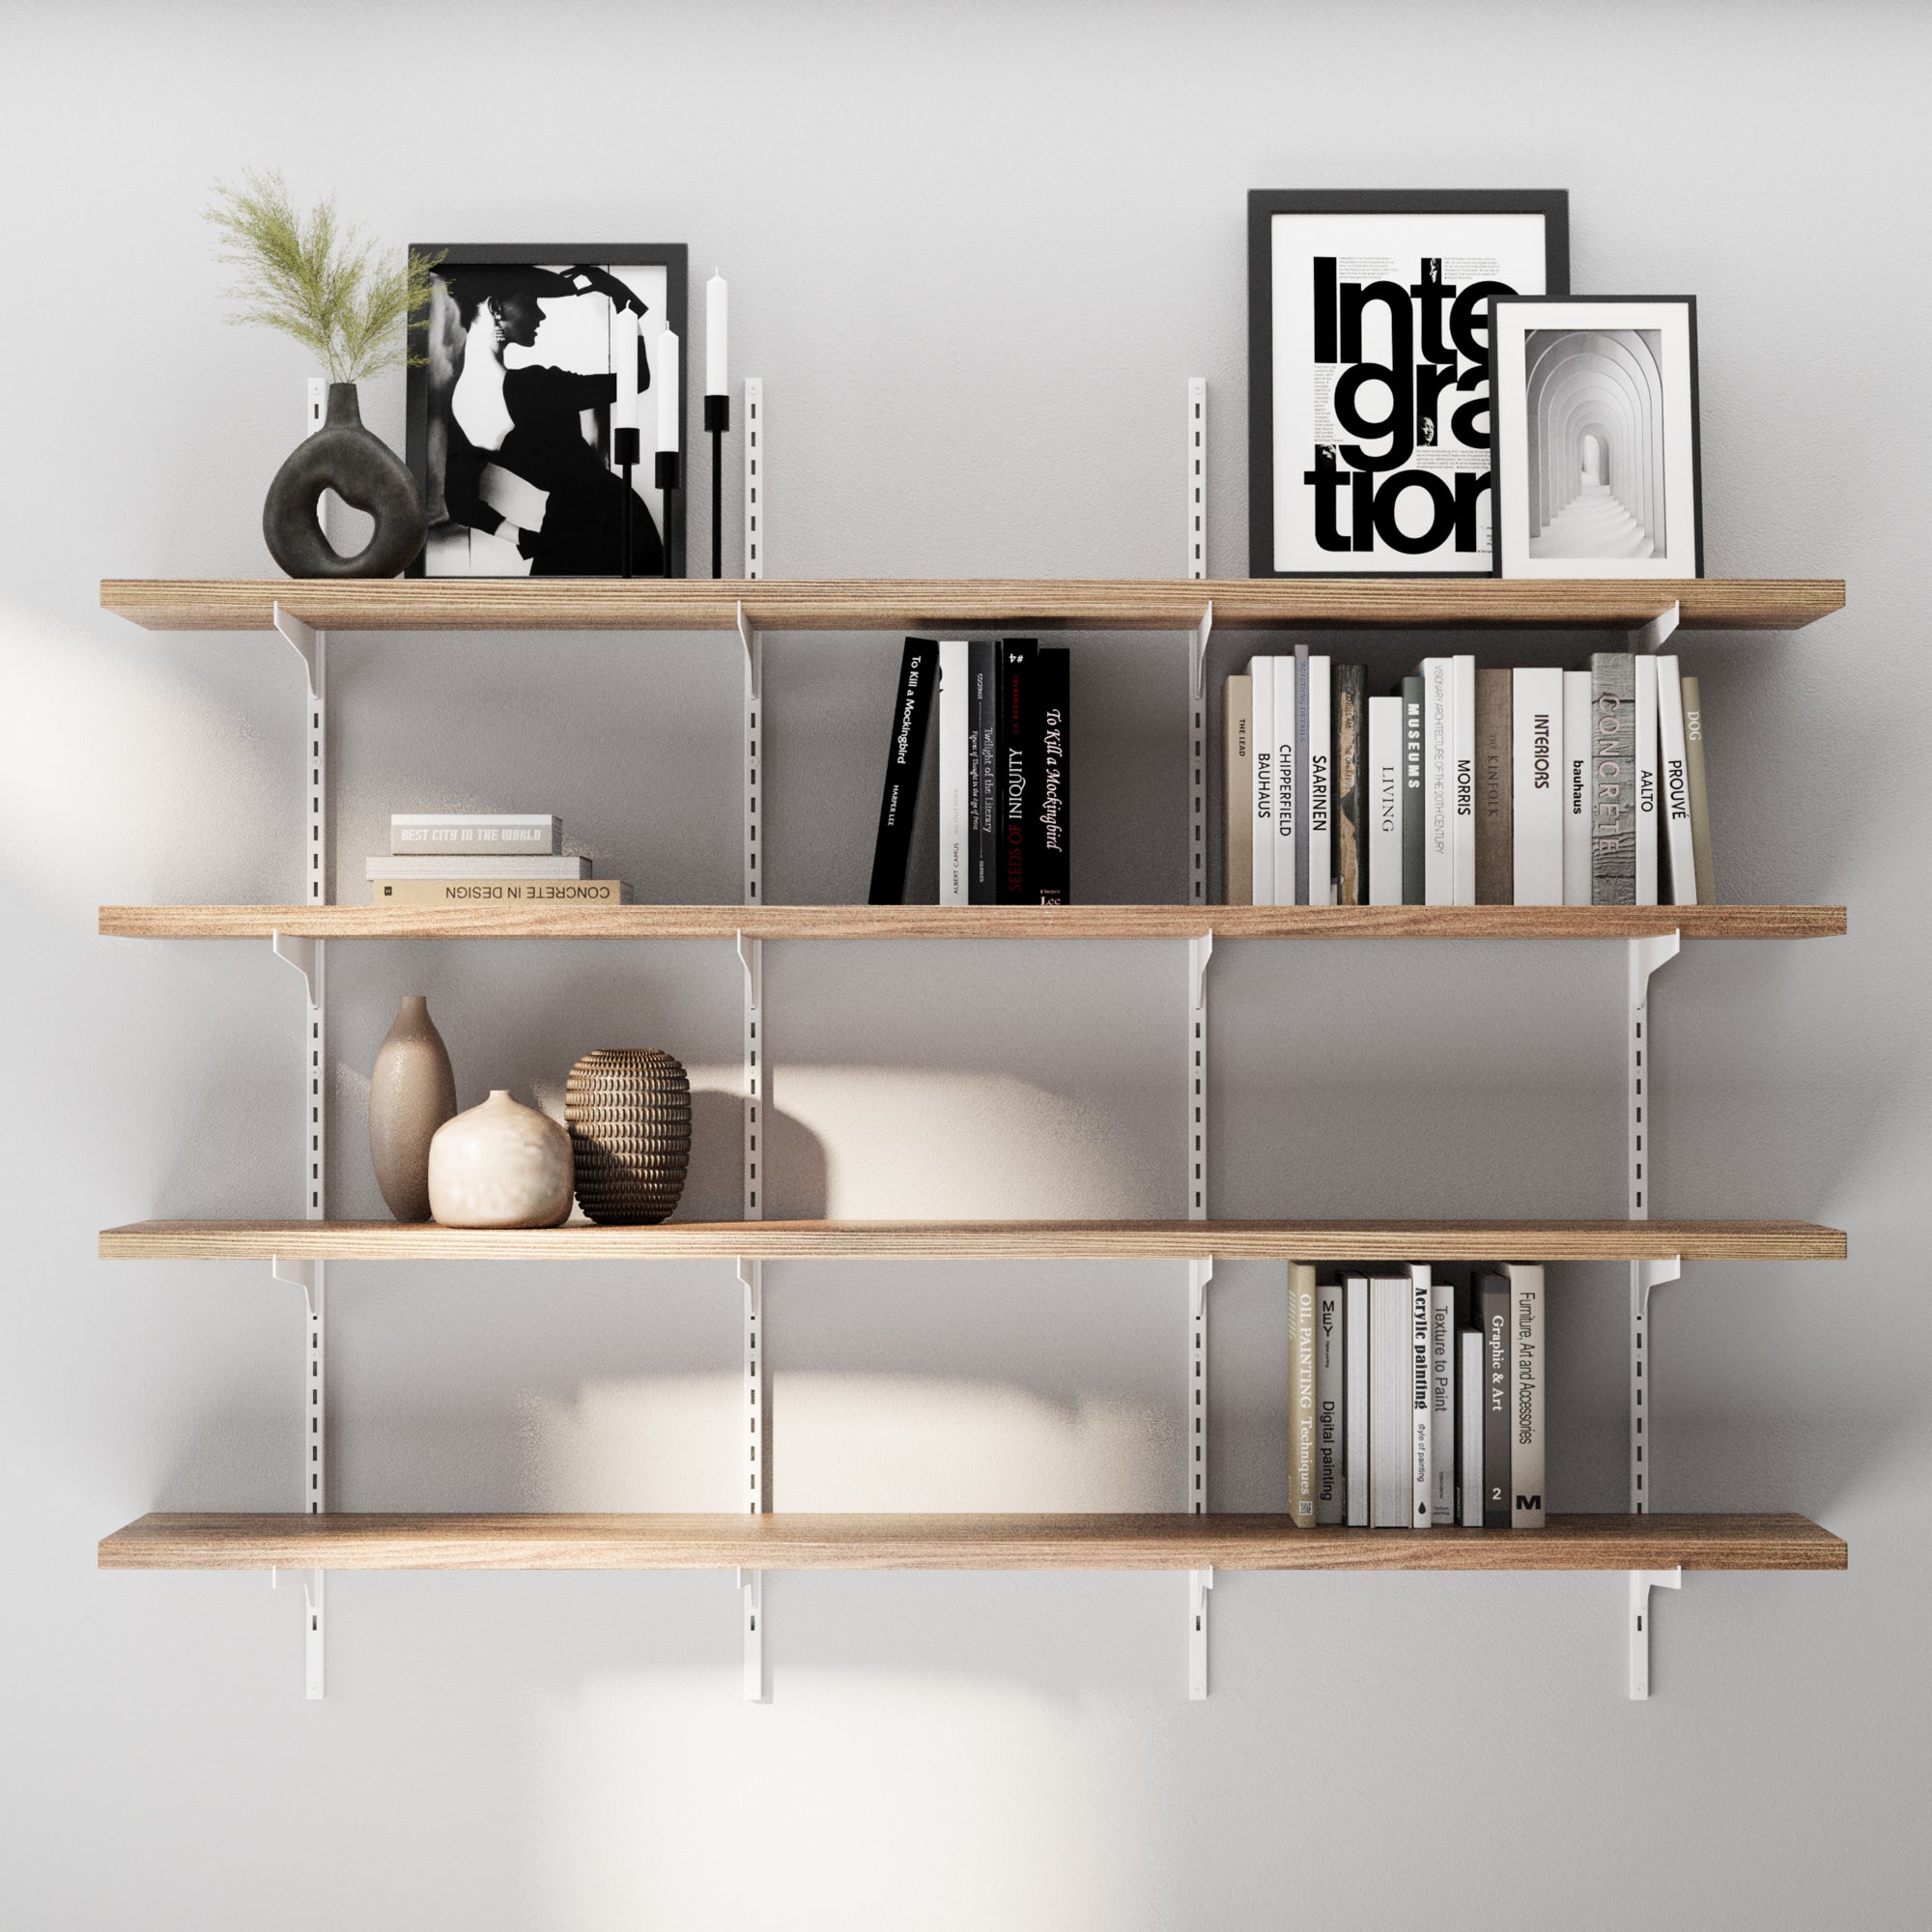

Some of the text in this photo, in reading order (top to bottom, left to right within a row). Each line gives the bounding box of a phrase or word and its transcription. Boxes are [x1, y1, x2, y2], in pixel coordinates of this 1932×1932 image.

[908, 671, 919, 687] Kill
[910, 656, 922, 668] To
[1009, 653, 1024, 664] #4
[1434, 665, 1444, 702] VISIONARY
[896, 697, 915, 764] Mockingbird
[1408, 703, 1420, 788] MUSEUMS
[1434, 702, 1444, 760] ARCHITECTURE
[1534, 714, 1549, 789] INTERIORS
[1687, 711, 1701, 741] DOG
[969, 758, 979, 781] Thought
[982, 726, 993, 833] Twilight of the Literary
[1039, 708, 1063, 853] To Kill a Mockingbird
[1258, 753, 1271, 818] BAUHAUS
[1279, 744, 1293, 837] CHIPPERFIELD
[1313, 755, 1327, 831] SAARINEN
[1434, 761, 1444, 774] OF
[1434, 774, 1444, 789] THE
[1457, 759, 1471, 816] MORRIS
[1488, 755, 1498, 817] KINFOLK
[1573, 760, 1584, 814] bauhaus
[1598, 693, 1621, 852] CONCRETE
[1640, 770, 1654, 812] AALTO
[1668, 759, 1690, 820] PROUVÉ
[890, 784, 899, 811] HARPER
[1009, 748, 1026, 892] SEEDS OF INIQUITY
[1381, 767, 1395, 833] LIVING
[401, 829, 542, 841] BEST CITY IN THE WORLD
[1434, 813, 1445, 856] CENTURY
[445, 887, 611, 899] CONCRETE IN DESIGN
[1322, 1300, 1335, 1337] MEY
[1414, 1287, 1428, 1409] Acrylic painting
[1435, 1306, 1448, 1412] Texture to Paint
[1489, 1315, 1504, 1412] Graphic & Art
[1518, 1293, 1536, 1445] Furniture, Art and Accessories
[1299, 1293, 1313, 1495] OIL PAINTING Techniques
[1320, 1401, 1335, 1501] Digital painting
[1417, 1423, 1426, 1441] style
[1417, 1442, 1426, 1452] of
[1492, 1487, 1501, 1500] 2
[1516, 1494, 1542, 1510] M
